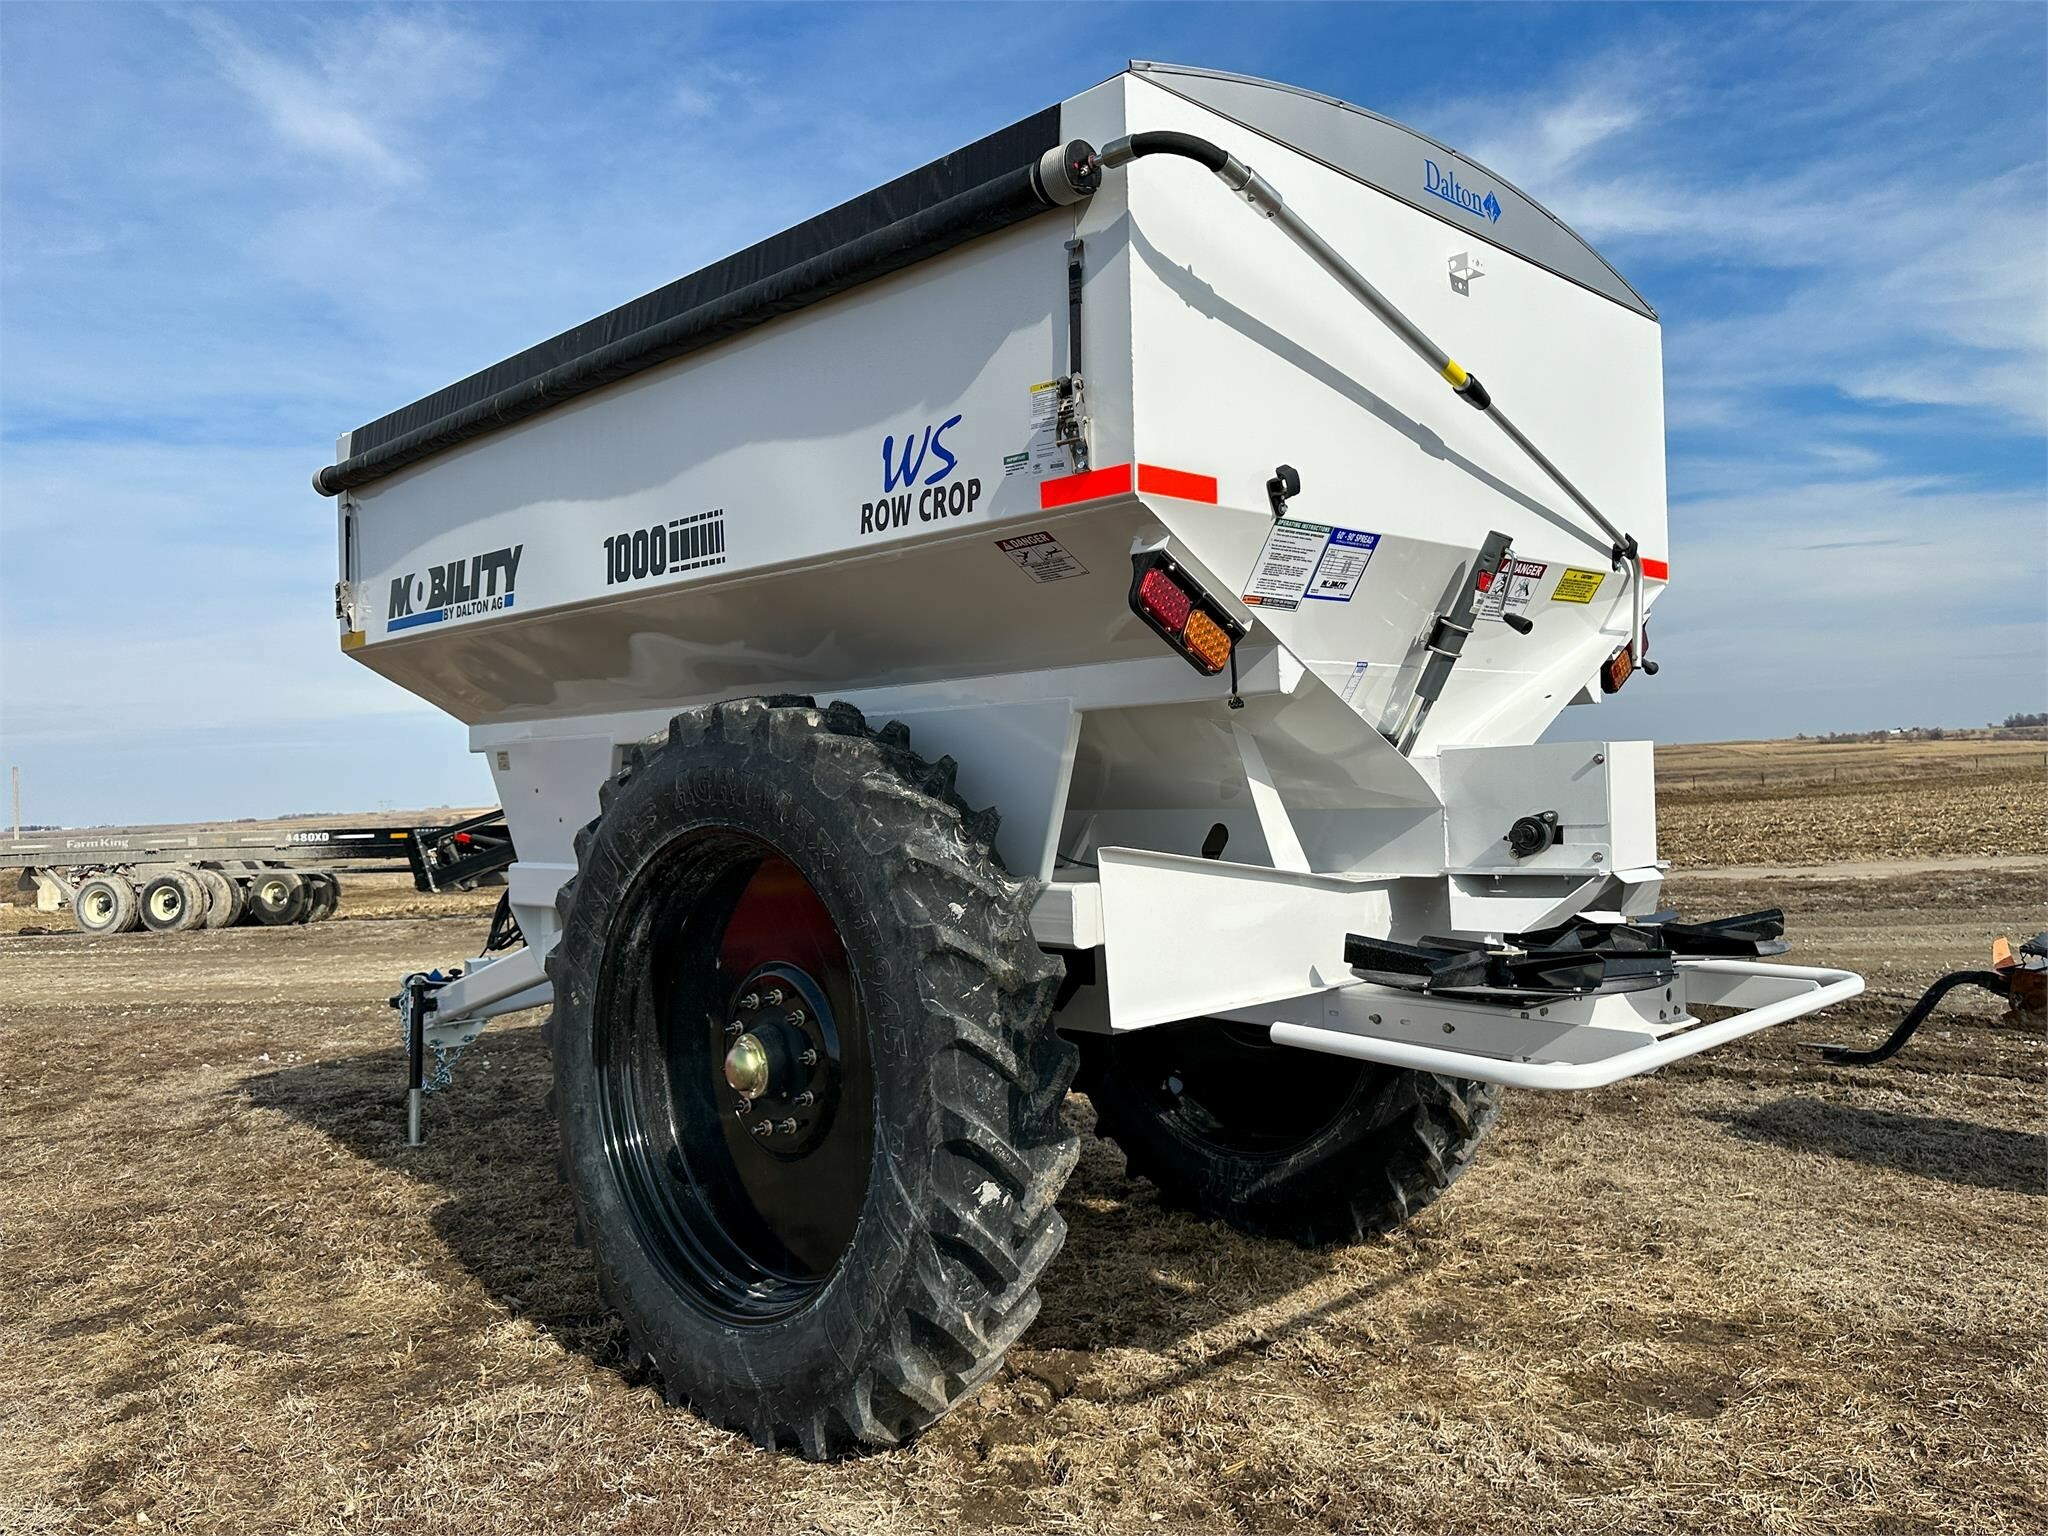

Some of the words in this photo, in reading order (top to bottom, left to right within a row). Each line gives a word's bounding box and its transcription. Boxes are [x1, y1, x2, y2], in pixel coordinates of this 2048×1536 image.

[1424, 159, 1483, 214] Dalton
[882, 414, 962, 493] WS
[860, 492, 912, 535] ROW
[918, 478, 981, 522] CROP
[603, 524, 667, 585] 1000
[1009, 533, 1050, 548] DANGER
[1354, 534, 1374, 544] SPREAD
[388, 544, 524, 620] MOBILITY
[443, 606, 454, 621] BY
[456, 599, 489, 618] DALTON
[491, 596, 503, 611] AG
[66, 838, 99, 849] Farm
[99, 837, 130, 849] King
[285, 832, 330, 843] 4480XD
